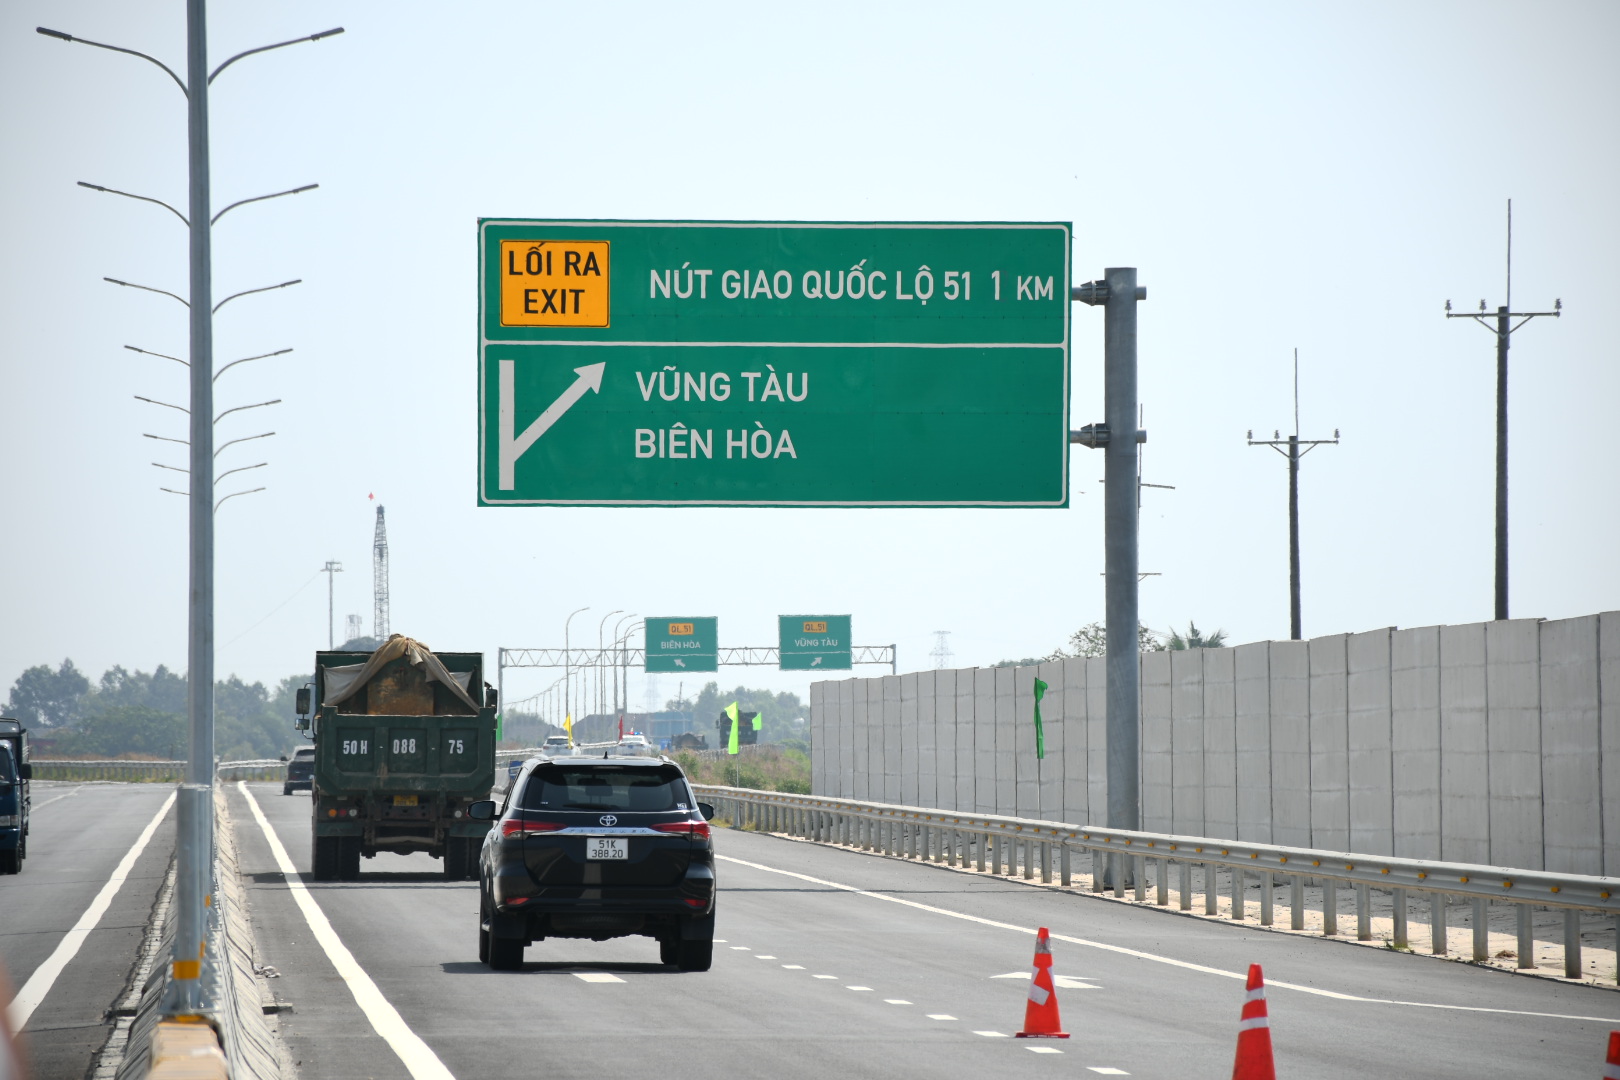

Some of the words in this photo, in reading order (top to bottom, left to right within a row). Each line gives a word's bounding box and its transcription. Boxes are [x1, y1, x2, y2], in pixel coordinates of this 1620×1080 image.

[508, 242, 552, 276] LỐI
[564, 250, 601, 277] RA
[650, 262, 713, 299] NÚT
[721, 269, 793, 300] GIAO
[802, 258, 887, 301] QUỐC
[895, 264, 934, 306] LỘ
[943, 271, 971, 301] 51
[991, 270, 1001, 301] 1
[1017, 275, 1054, 301] KM
[524, 288, 586, 315] EXIT
[635, 365, 731, 402] VŨNG
[740, 364, 808, 402] TÀU
[635, 421, 713, 459] BIÊN
[726, 420, 798, 459] HÒA
[660, 639, 682, 649] BIÊN
[683, 639, 701, 649] HÒA
[820, 637, 838, 646] TÀU
[393, 738, 416, 754] 088
[448, 739, 464, 754] 75
[591, 849, 624, 858] 388.20
[598, 839, 616, 849] 51K
